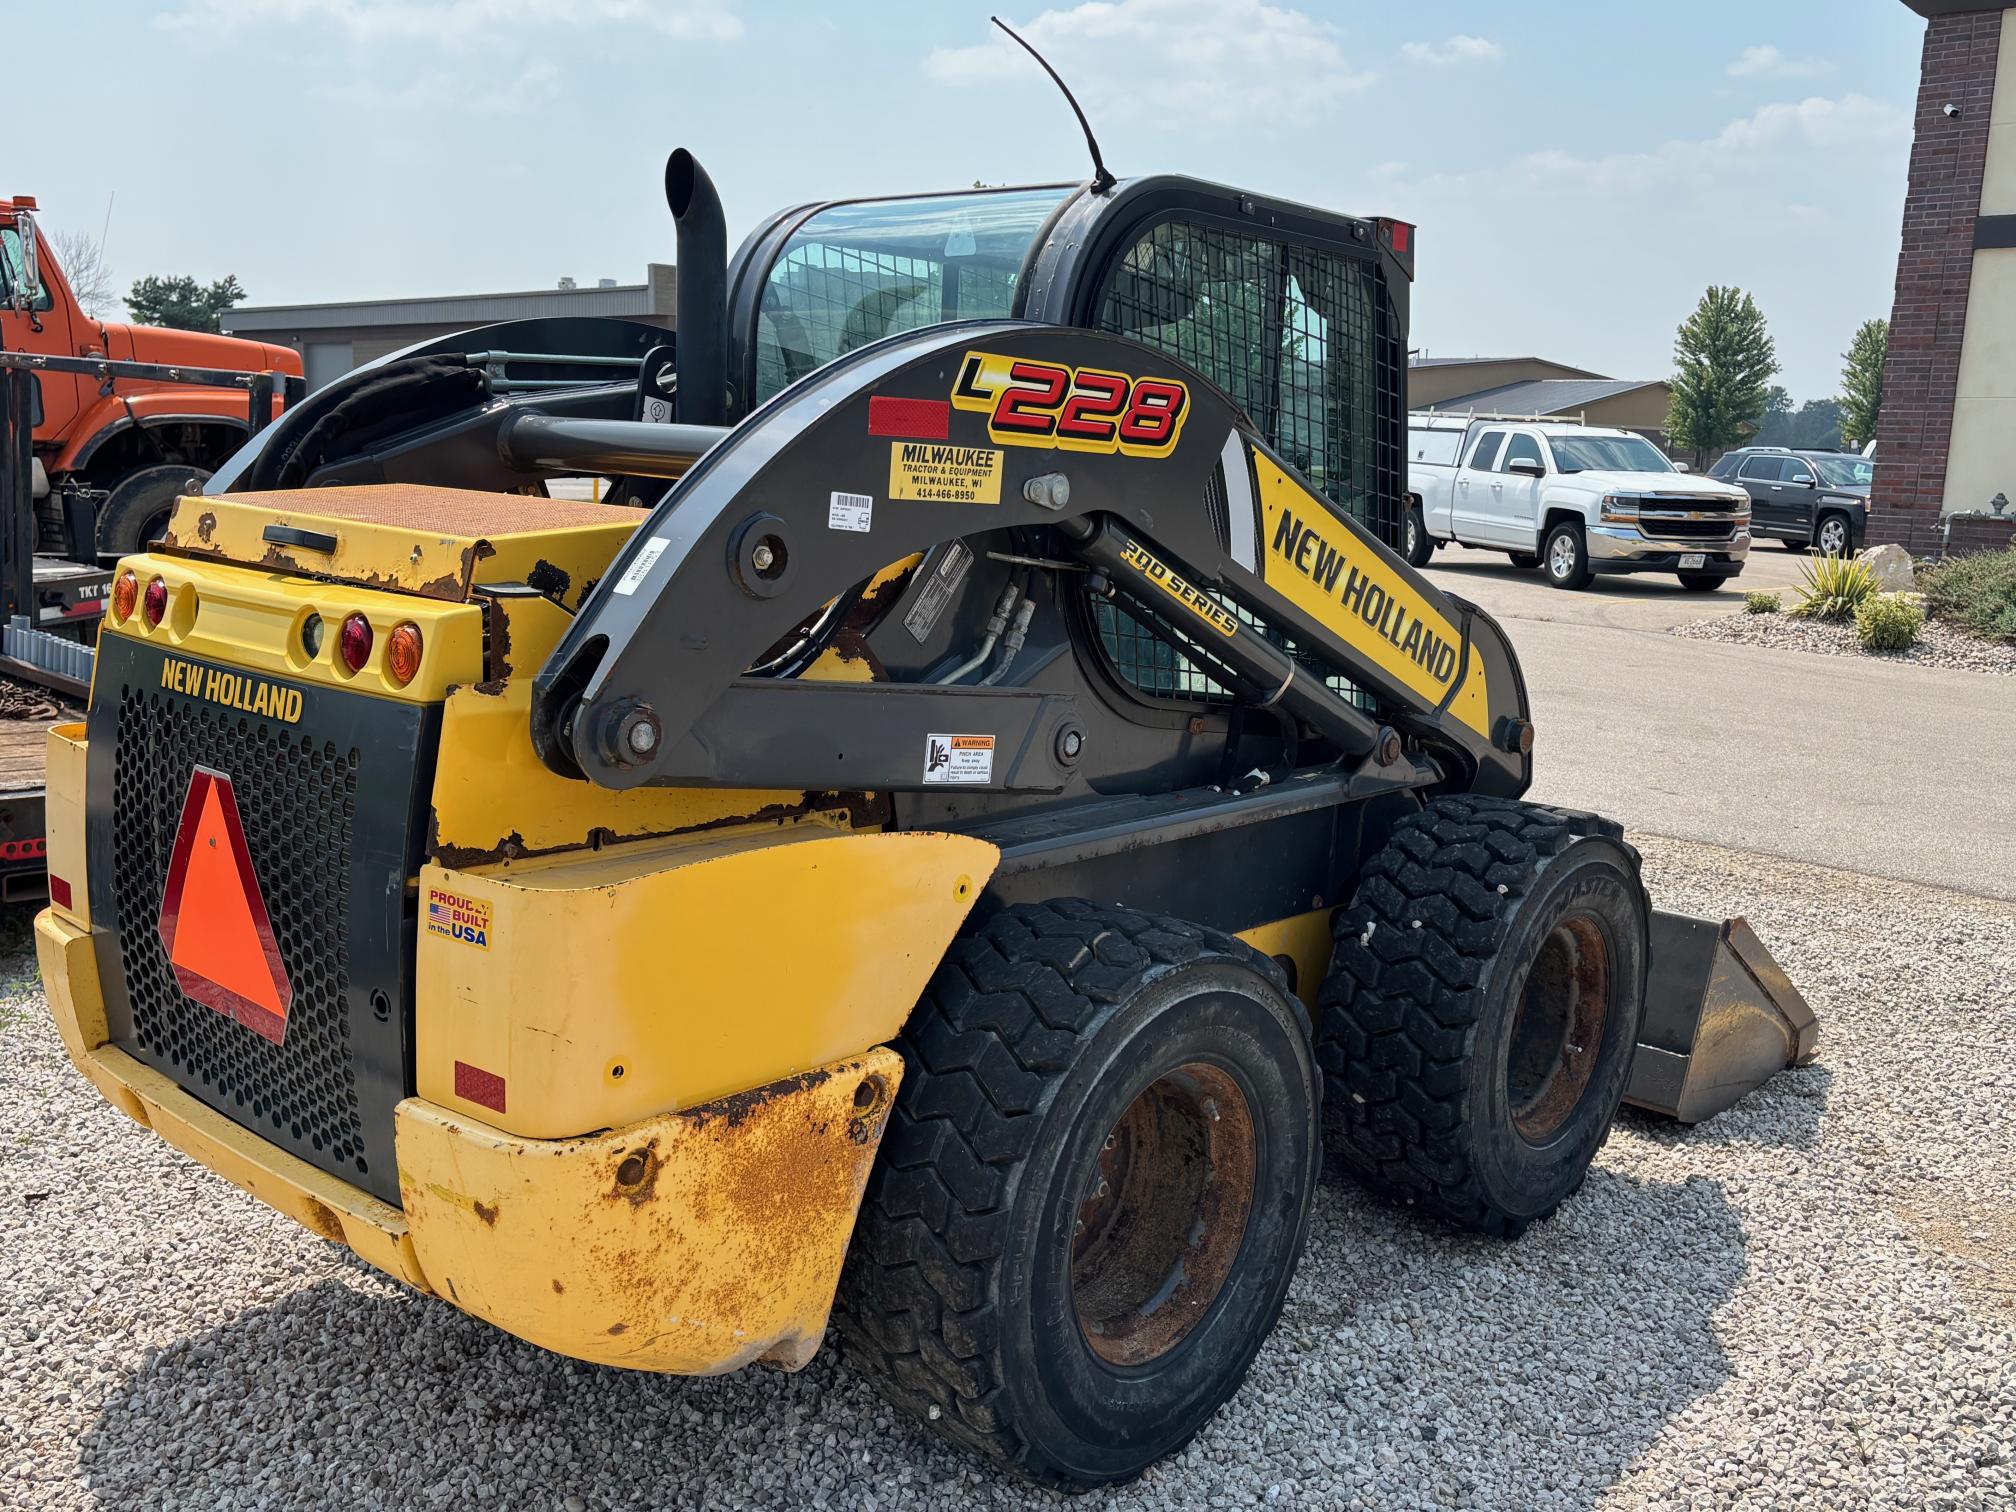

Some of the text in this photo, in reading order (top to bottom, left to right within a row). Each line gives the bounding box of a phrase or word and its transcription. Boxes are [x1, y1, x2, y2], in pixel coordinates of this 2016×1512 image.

[953, 354, 1188, 450] L228
[902, 444, 995, 468] MILWAUKEE
[903, 463, 993, 478] TRACTOR & EQUIPMENT
[911, 475, 983, 489] MILWAUKEE, WI
[916, 488, 976, 501] 414-466-8950
[79, 585, 98, 599] TKT
[1272, 507, 1457, 685] NEW HOLLAND
[1166, 575, 1237, 633] SERIES
[161, 657, 303, 724] NEW HOLLAND
[961, 739, 991, 747] WARNING
[452, 909, 489, 930] BUILT
[428, 921, 487, 947] in the USA
